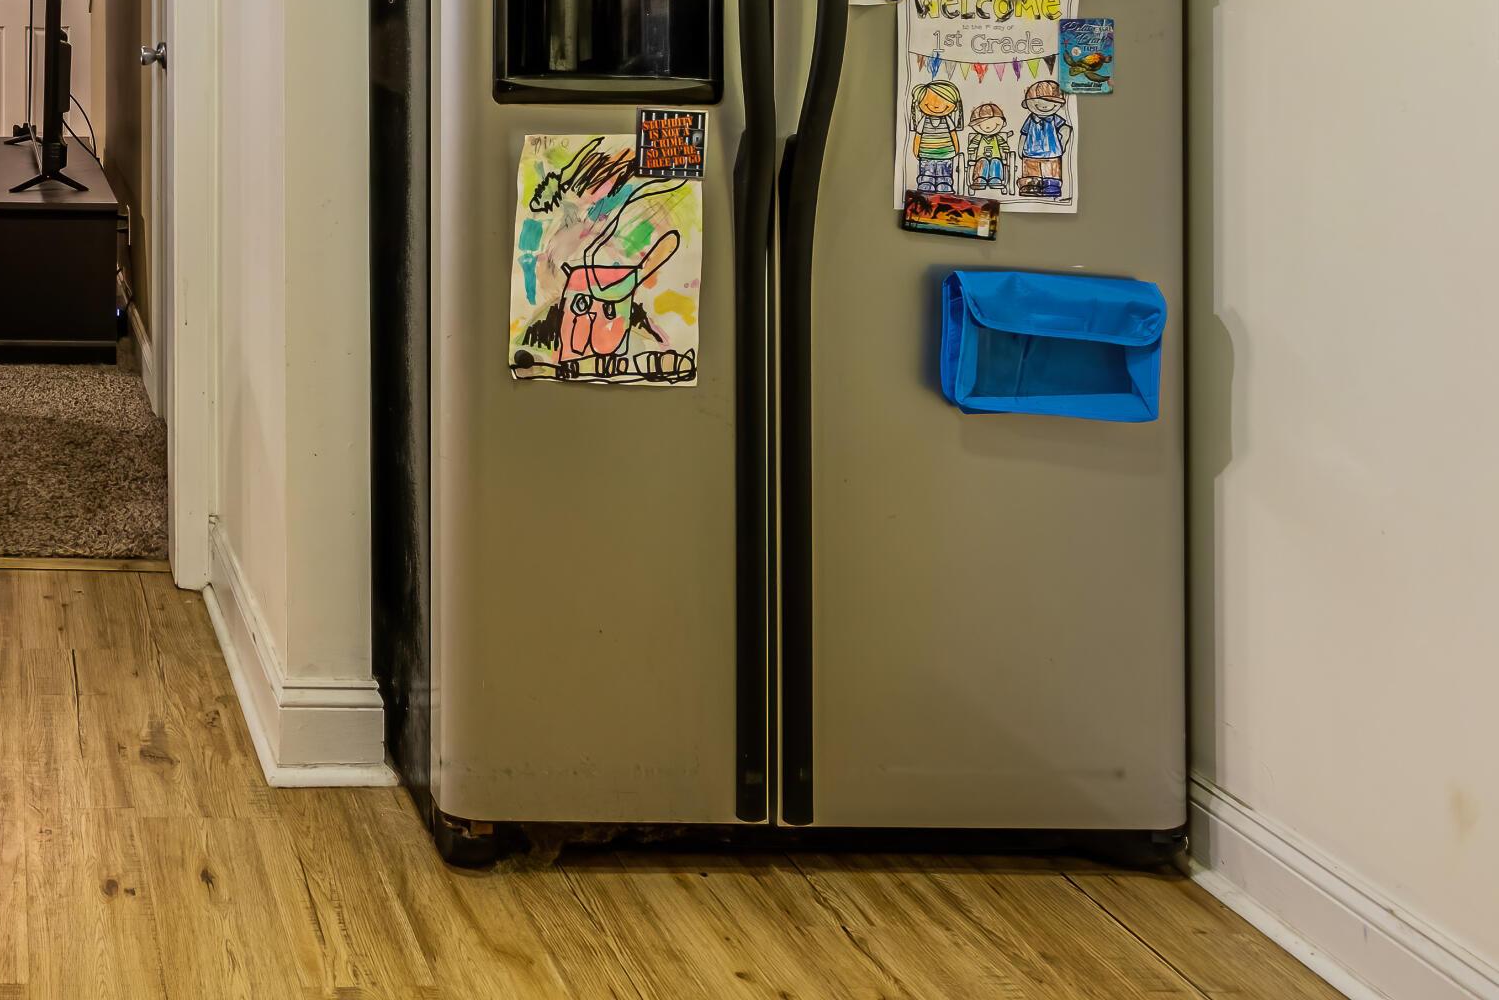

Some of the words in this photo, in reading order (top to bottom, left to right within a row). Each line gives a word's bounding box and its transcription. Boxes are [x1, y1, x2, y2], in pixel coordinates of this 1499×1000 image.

[932, 30, 963, 53] 1st
[970, 30, 1045, 55] Grade
[642, 116, 693, 130] STUPIDITY
[649, 130, 659, 140] IS
[661, 127, 680, 138] NOT
[682, 127, 690, 136] A
[646, 148, 659, 159] SO
[661, 144, 696, 157] YOU'RE
[645, 157, 671, 169] FREE
[672, 155, 686, 166] TO
[688, 154, 701, 164] GO
